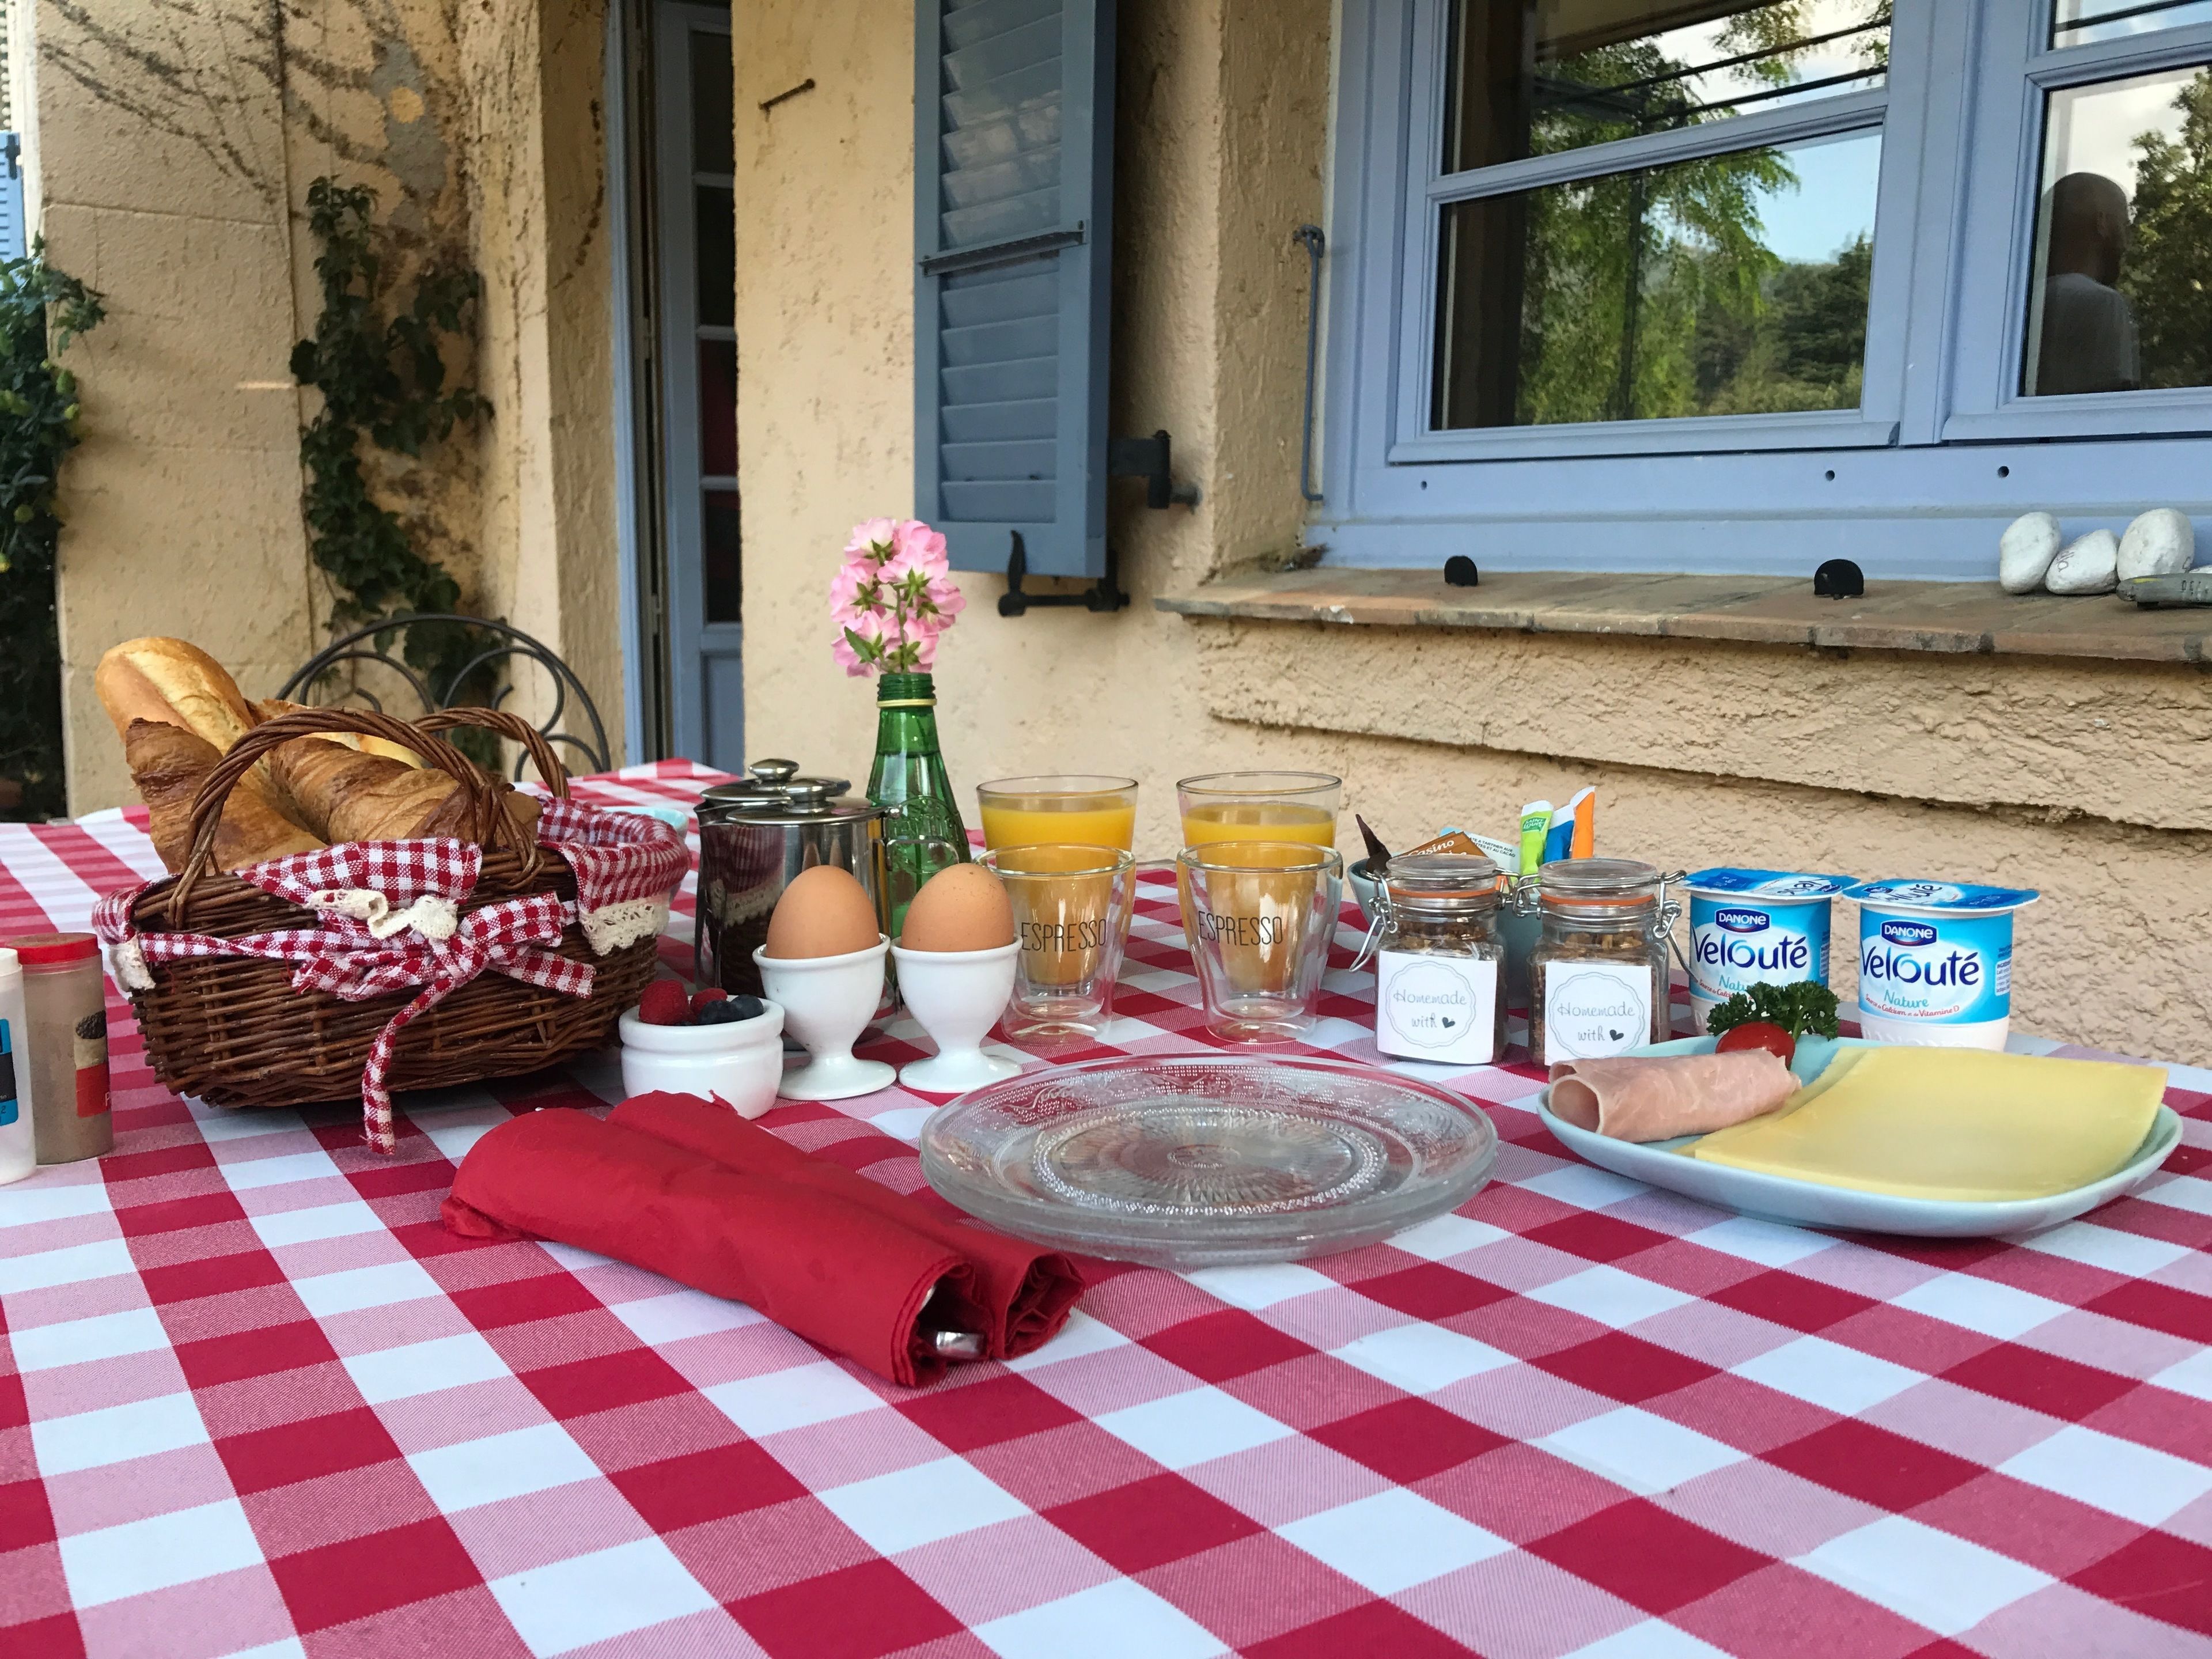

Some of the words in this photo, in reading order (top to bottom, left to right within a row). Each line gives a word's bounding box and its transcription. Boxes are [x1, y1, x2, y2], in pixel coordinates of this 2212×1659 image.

[1523, 821, 1544, 830] LOUIS
[1407, 840, 1455, 856] Casino
[1482, 840, 1503, 849] TARTINER
[1499, 850, 1516, 858] CACAO
[1021, 918, 1107, 952] ESPRESSO
[1198, 911, 1283, 946] ESPRESSO
[1691, 925, 1807, 969] Velouté
[1861, 939, 1979, 986] Velouté
[1393, 989, 1467, 1005] Homemade
[1884, 989, 1929, 1008] Nature
[1557, 1001, 1635, 1017] Homemade
[1882, 1004, 1906, 1016] Calcium
[1919, 1008, 1953, 1017] Vitamine
[1411, 1012, 1437, 1028] with
[1578, 1025, 1605, 1041] with
